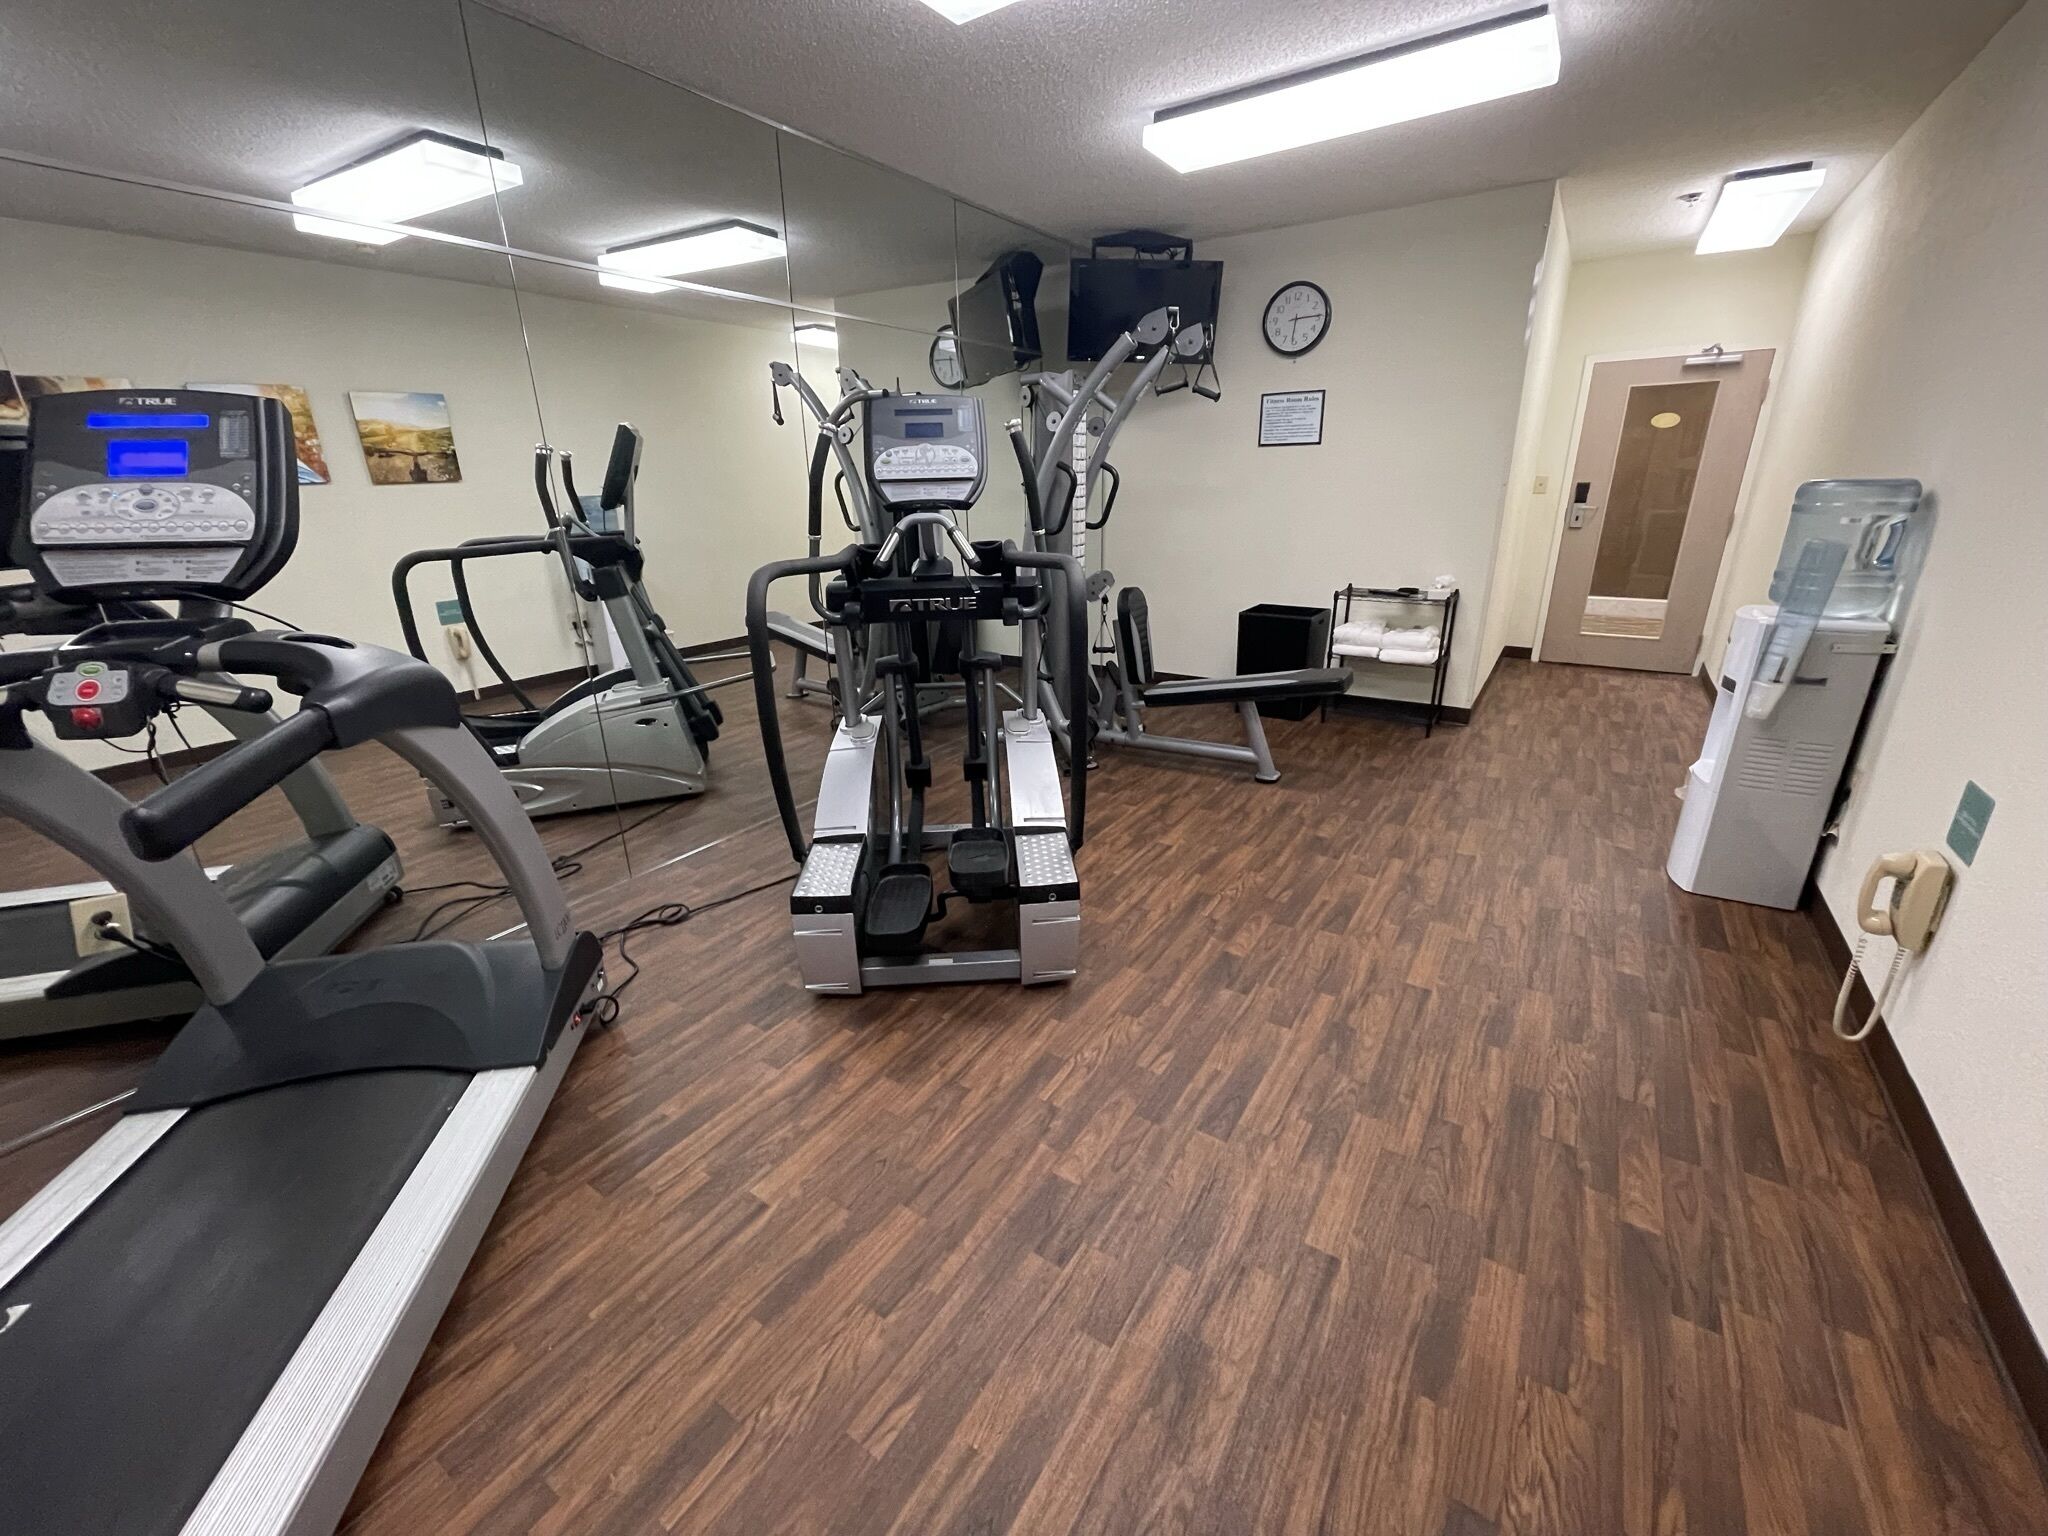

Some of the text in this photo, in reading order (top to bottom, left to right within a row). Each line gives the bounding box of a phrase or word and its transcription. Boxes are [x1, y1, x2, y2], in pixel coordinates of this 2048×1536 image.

[1285, 296, 1291, 305] 11
[1294, 291, 1303, 301] 12
[1276, 305, 1285, 314] 10
[1312, 301, 1319, 310] 2
[1272, 317, 1279, 326] 9
[1274, 328, 1281, 337] 8
[1310, 324, 1316, 333] 4
[1282, 335, 1288, 344] 7
[1302, 332, 1309, 342] 5
[137, 397, 177, 406] TRUE
[912, 596, 977, 611] TRUE
